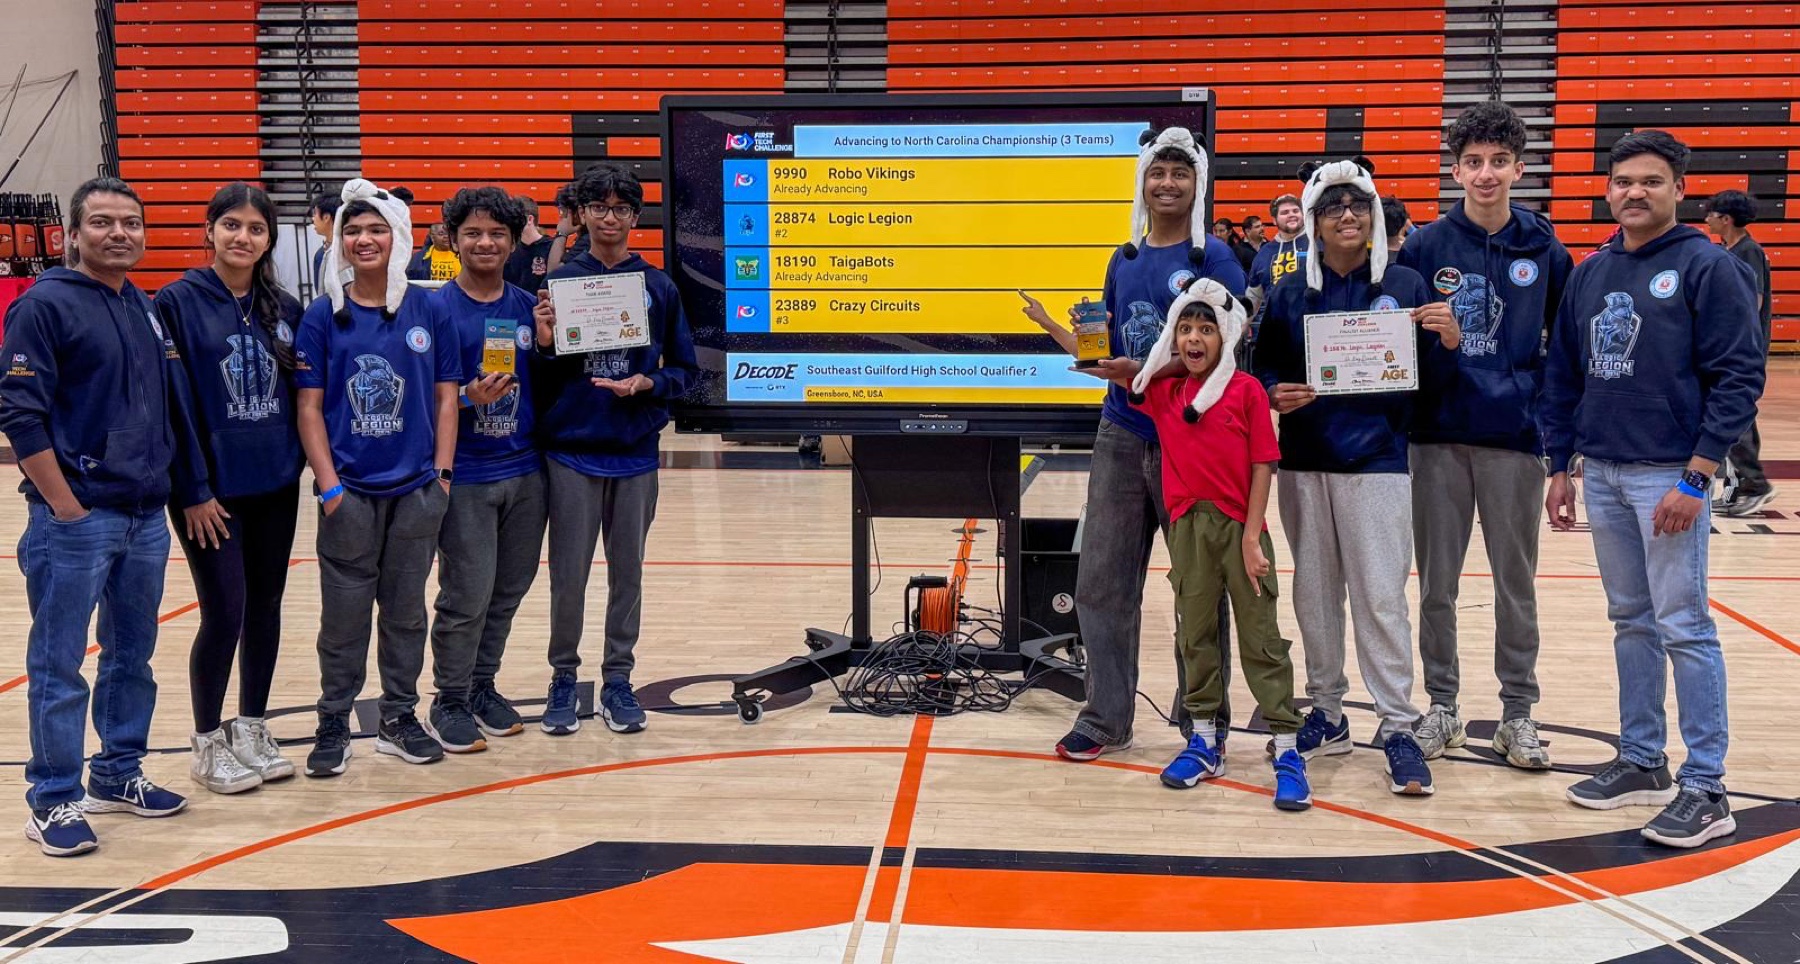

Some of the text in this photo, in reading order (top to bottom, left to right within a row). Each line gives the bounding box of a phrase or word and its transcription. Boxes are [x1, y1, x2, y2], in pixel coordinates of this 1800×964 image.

[834, 134, 1114, 148] Advancing to North Carolina Championship (3 Teams)
[754, 144, 793, 152] CHALLENGE
[773, 167, 916, 182] 9990 Robo Vikings
[773, 184, 868, 196] Already Advancing
[774, 211, 913, 227] 28874 Logic Legion
[774, 229, 788, 239] #2
[775, 256, 895, 270] 18190 TaigaBots
[774, 272, 868, 284] Already Advancing
[775, 300, 921, 315] 23889 Crazy Circuits
[775, 316, 790, 325] #3
[619, 327, 642, 338] AGE
[585, 359, 629, 372] LEGION
[807, 364, 1037, 378] Southeast Guilford High School Qualifier 2
[1589, 360, 1633, 373] LEGION
[1380, 369, 1409, 381] AGE
[807, 389, 884, 400] Greensboro, NC, USA
[228, 401, 279, 416] LEGION
[351, 420, 403, 432] LEGION
[474, 421, 517, 432] LEGION
